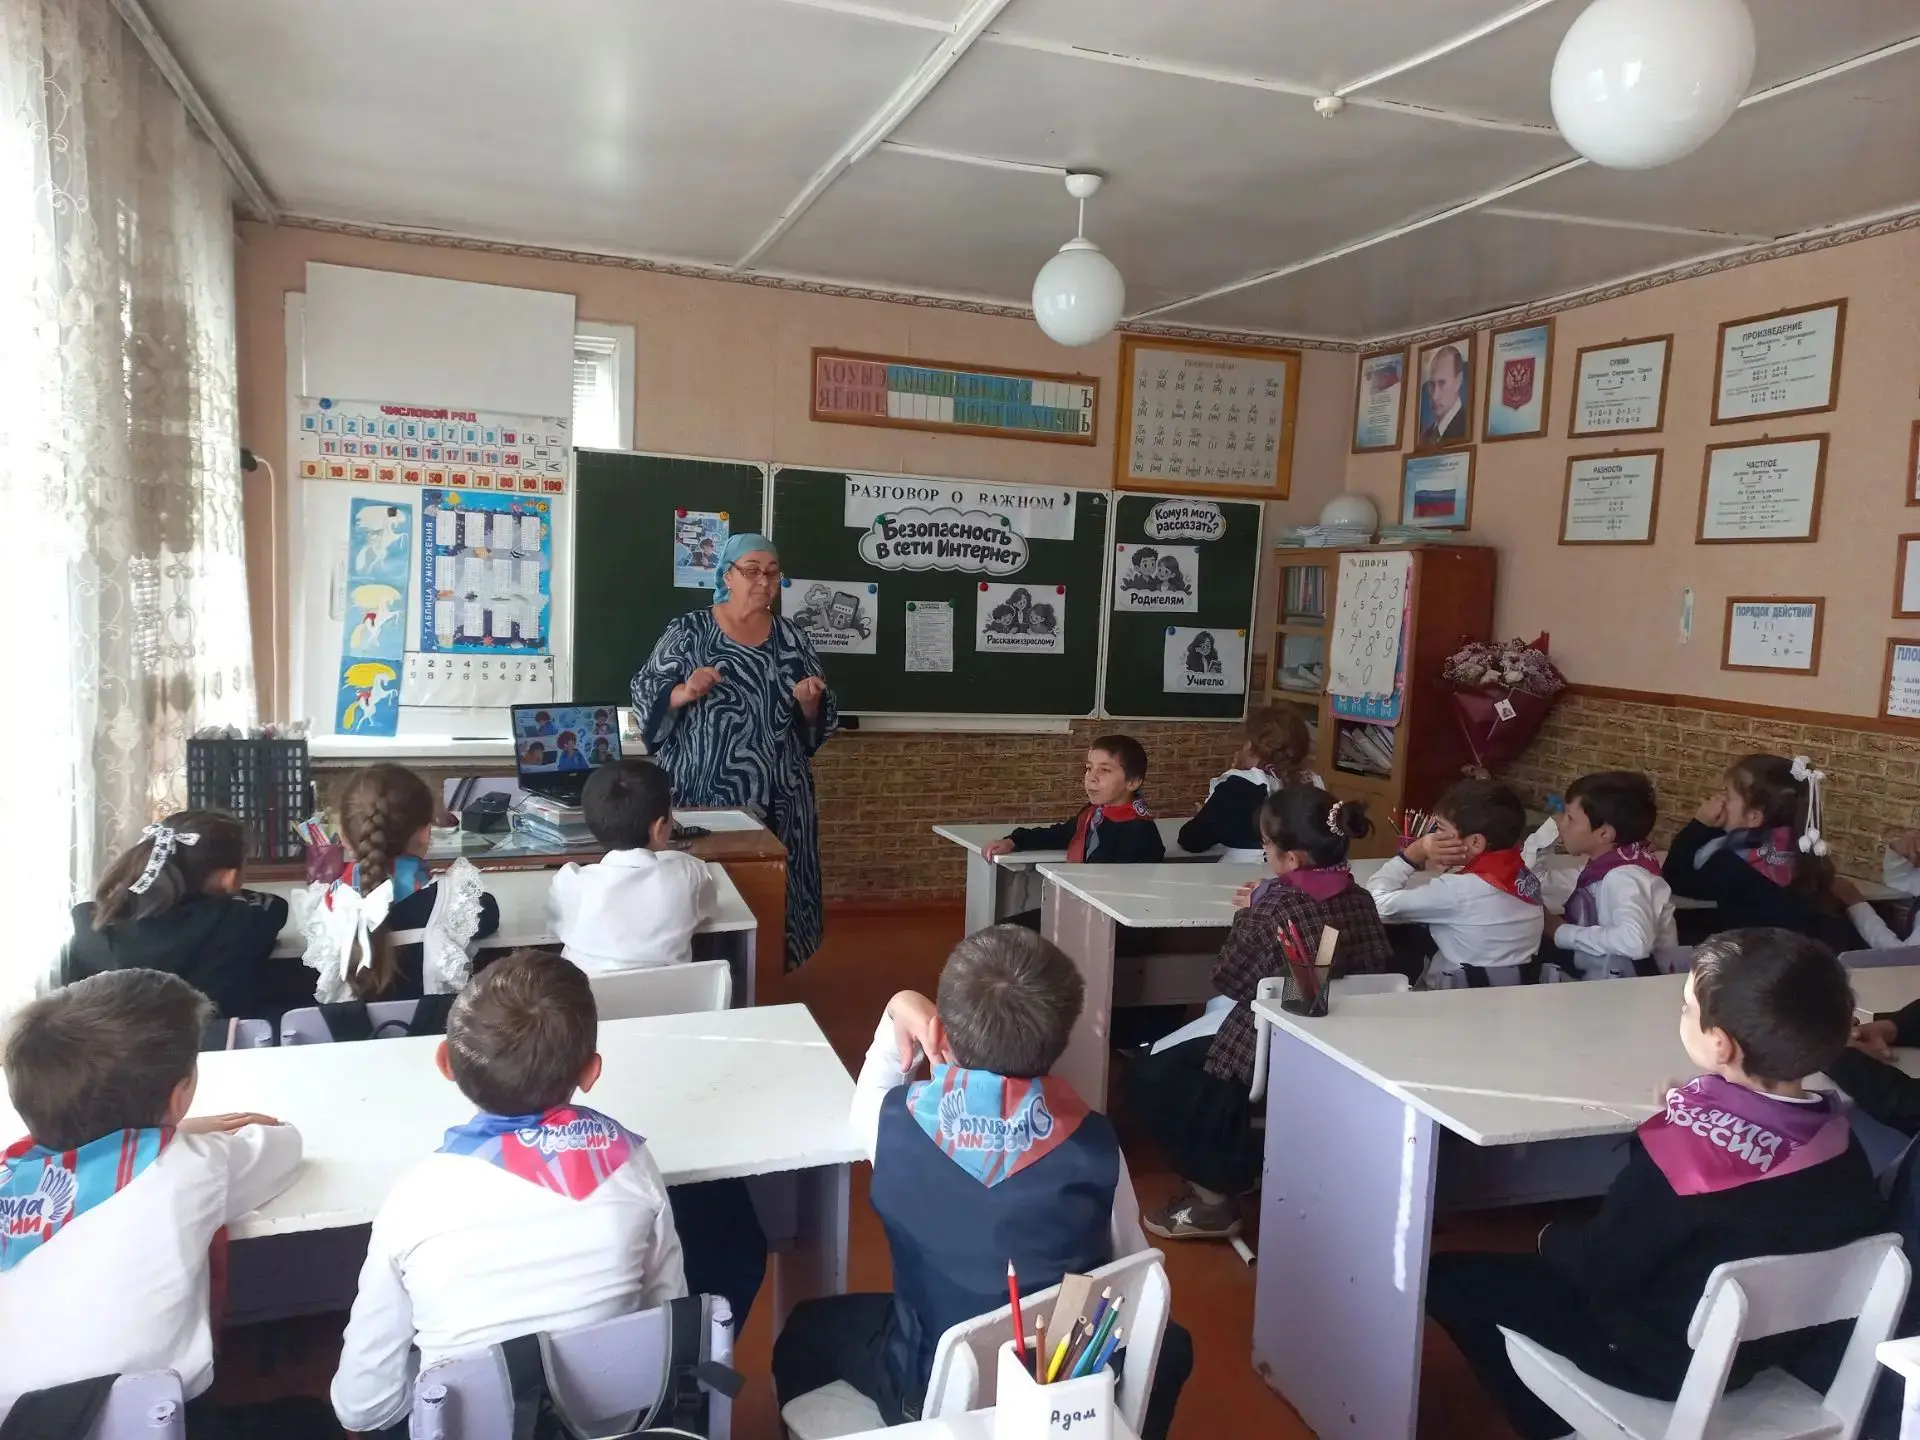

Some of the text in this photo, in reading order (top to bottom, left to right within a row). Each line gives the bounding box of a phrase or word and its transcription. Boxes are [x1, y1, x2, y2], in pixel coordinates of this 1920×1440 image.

[1742, 322, 1803, 342] ПРОИЗВЕДЕНИЕ
[380, 404, 477, 423] ЧИСЛОВОЙ РЯД
[306, 418, 314, 429] 0
[326, 419, 332, 430] 1
[347, 421, 356, 432] 2
[367, 422, 375, 433] 3
[388, 424, 395, 435] 4
[407, 425, 415, 436] 5
[427, 427, 436, 438] 6
[447, 428, 454, 439] 7
[503, 433, 515, 443] 10
[324, 442, 335, 452] 11
[344, 443, 357, 454] 12
[364, 444, 377, 455] 13
[385, 445, 398, 456] 14
[405, 447, 418, 457] 15
[426, 449, 439, 459] 16
[446, 450, 459, 460] 17
[467, 452, 479, 462] 18
[485, 452, 498, 464] 19
[505, 455, 518, 465] 20
[1746, 459, 1778, 469] ЧАСТНОЕ
[307, 465, 315, 475] 0
[330, 466, 343, 477] 10
[355, 468, 369, 479] 20
[380, 470, 394, 480] 30
[405, 471, 419, 481] 40
[429, 473, 442, 484] 50
[452, 474, 466, 484] 60
[476, 476, 490, 486] 70
[500, 477, 513, 488] 80
[523, 479, 537, 489] 90
[543, 481, 562, 491] 100
[850, 483, 1055, 510] РАЗГОВОР О ВАЖНОМ
[1190, 509, 1216, 522] могу
[882, 519, 1012, 546] Безопасность
[1156, 520, 1219, 534] рассказать?
[876, 540, 1021, 565] в сети Интернет
[424, 522, 433, 633] ТАБЛИЦА УМНОЖЕНИЯ
[1130, 593, 1184, 605] Родителям
[1370, 578, 1381, 600] 2
[1389, 578, 1400, 600] 3
[1367, 607, 1379, 628] 5
[1386, 608, 1396, 629] 6
[1736, 604, 1813, 618] ПОРЯДОК ДЕЙСТВИЙ
[1350, 634, 1393, 658] 7 8 9
[482, 661, 488, 669] 5
[1362, 664, 1373, 686] 0
[427, 672, 434, 680] 8
[499, 673, 506, 681] 4
[530, 674, 536, 682] 2
[1187, 675, 1224, 687] Учителю
[1050, 1408, 1096, 1431] Адам
